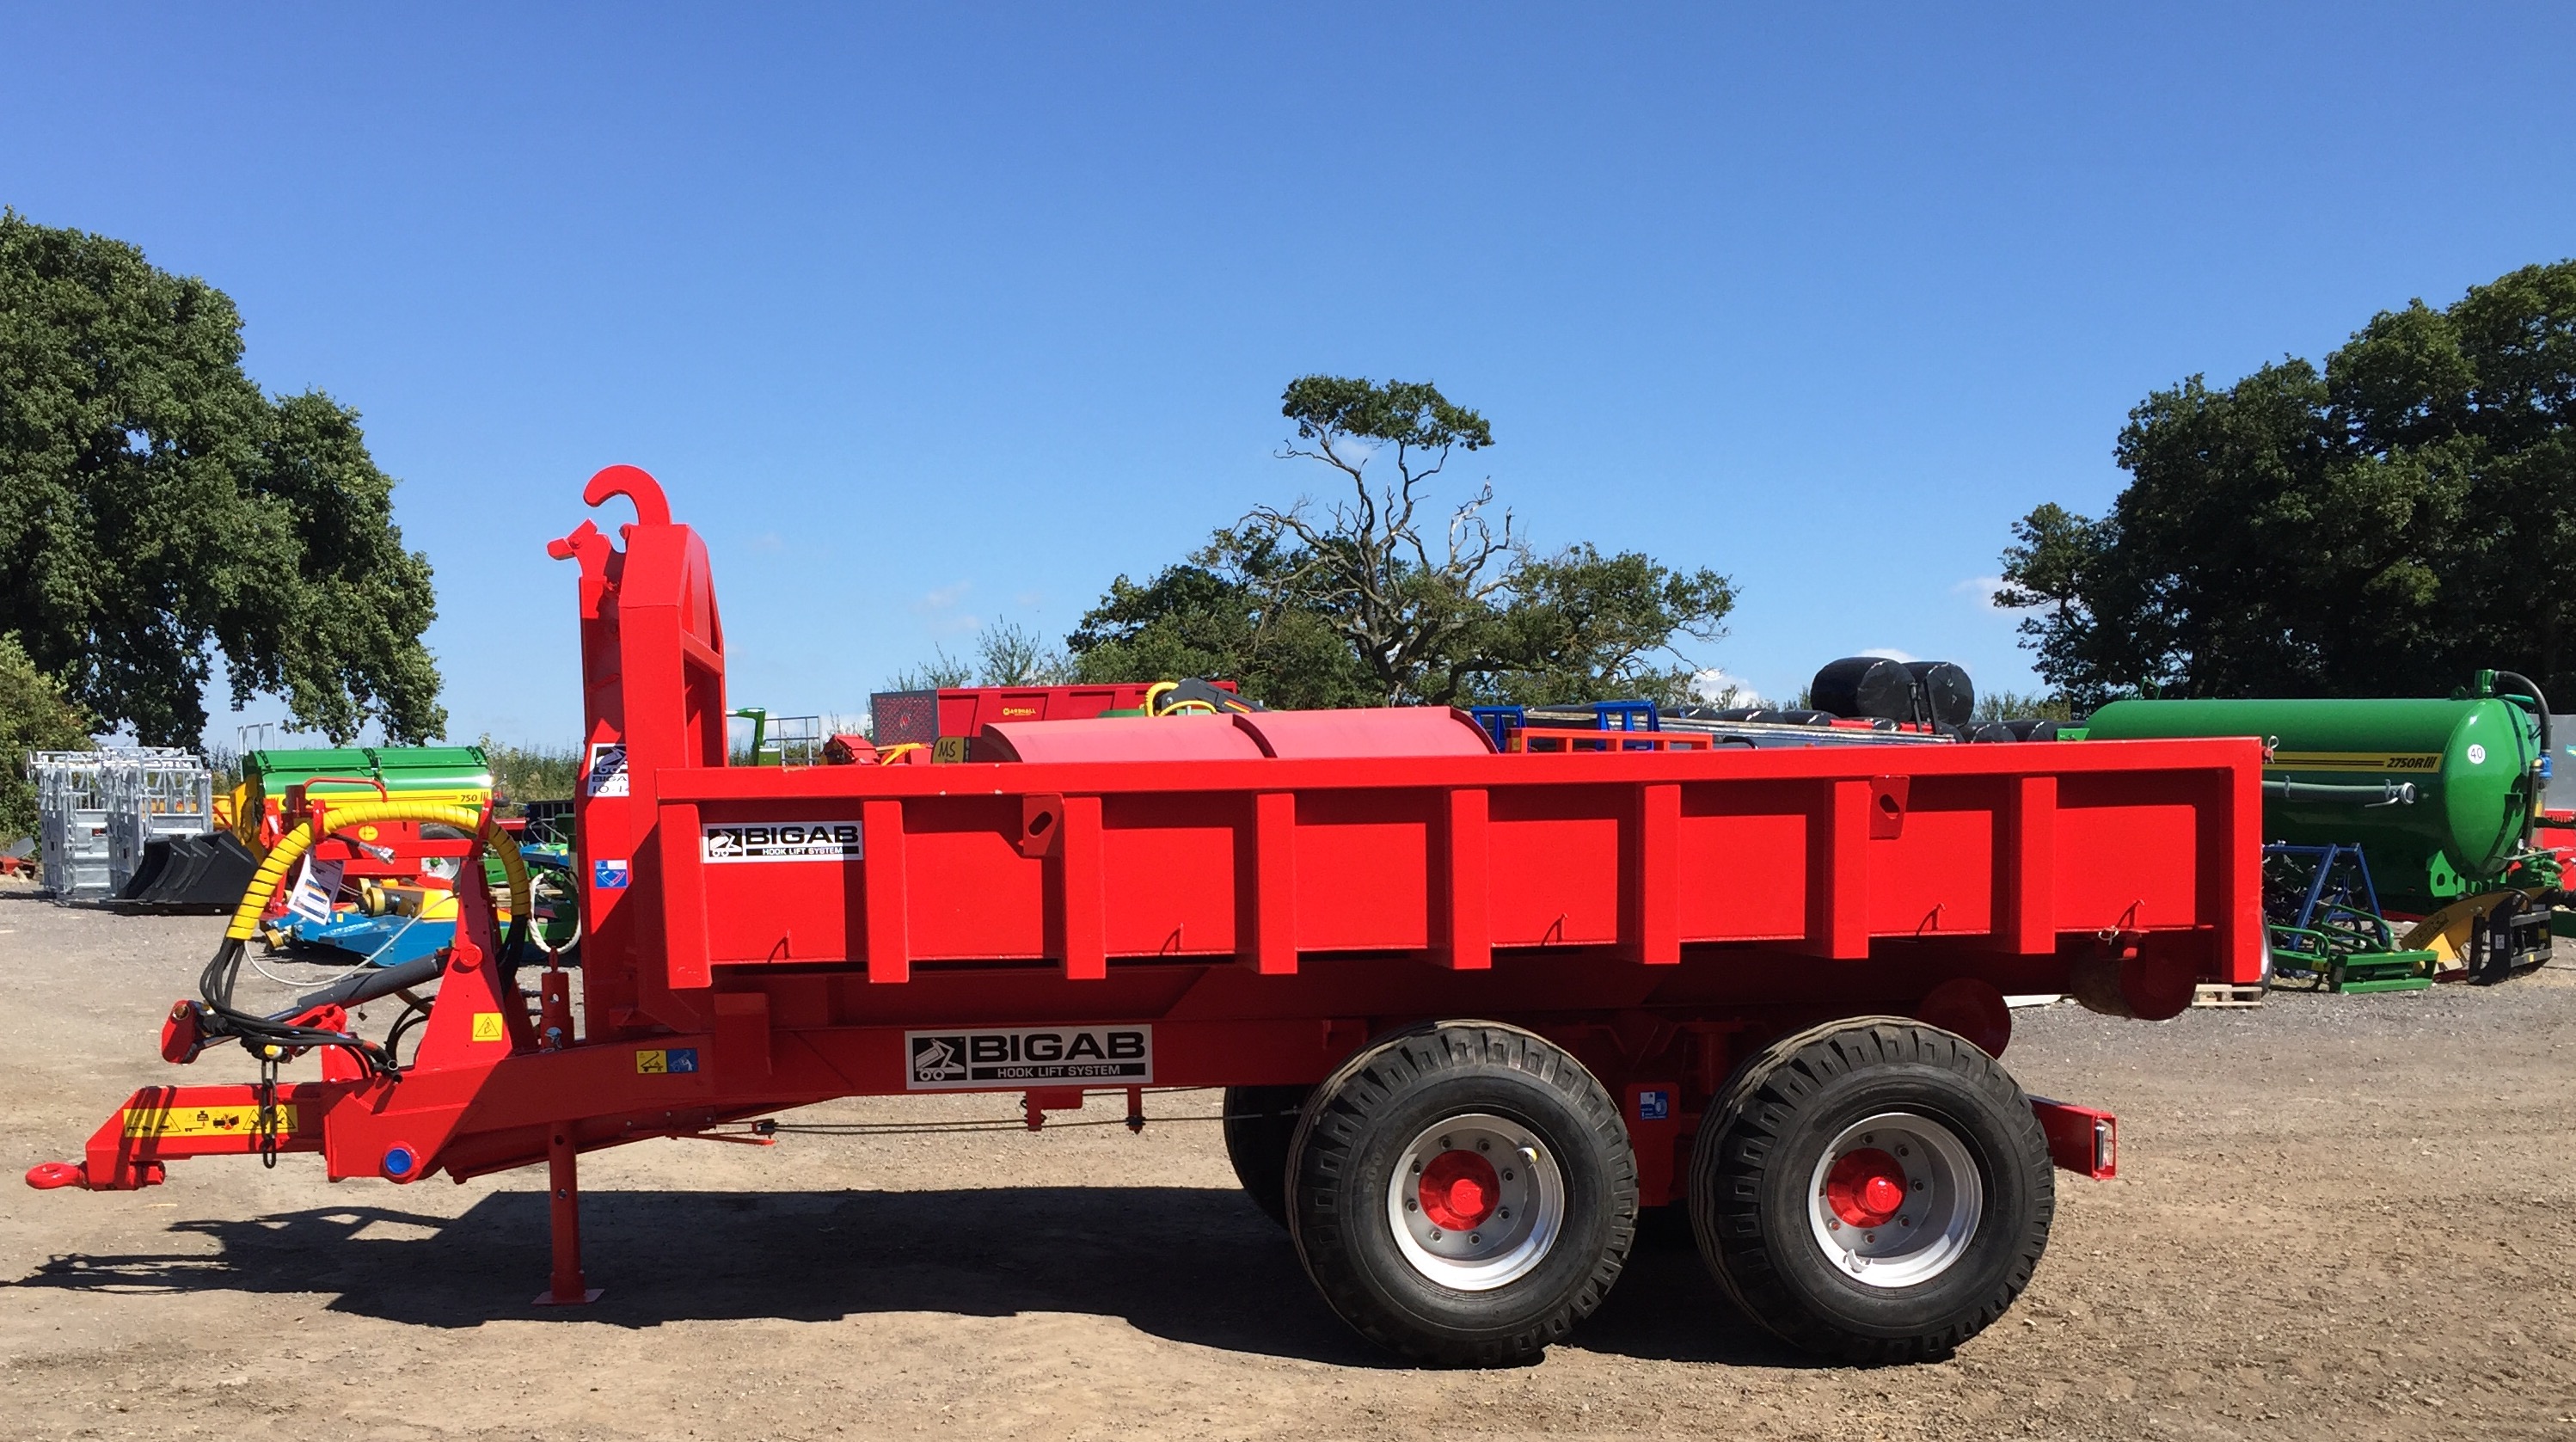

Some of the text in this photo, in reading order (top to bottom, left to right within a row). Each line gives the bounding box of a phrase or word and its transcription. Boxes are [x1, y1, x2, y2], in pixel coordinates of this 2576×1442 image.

[938, 741, 955, 758] MS
[2470, 747, 2483, 759] 40
[593, 785, 629, 794] 10-1
[460, 794, 477, 802] 750
[745, 825, 859, 845] BIGAB
[808, 846, 843, 855] SYSTEM
[970, 1032, 1145, 1063] BIGAB
[997, 1065, 1121, 1078] HOOK LIFT SYSTEM
